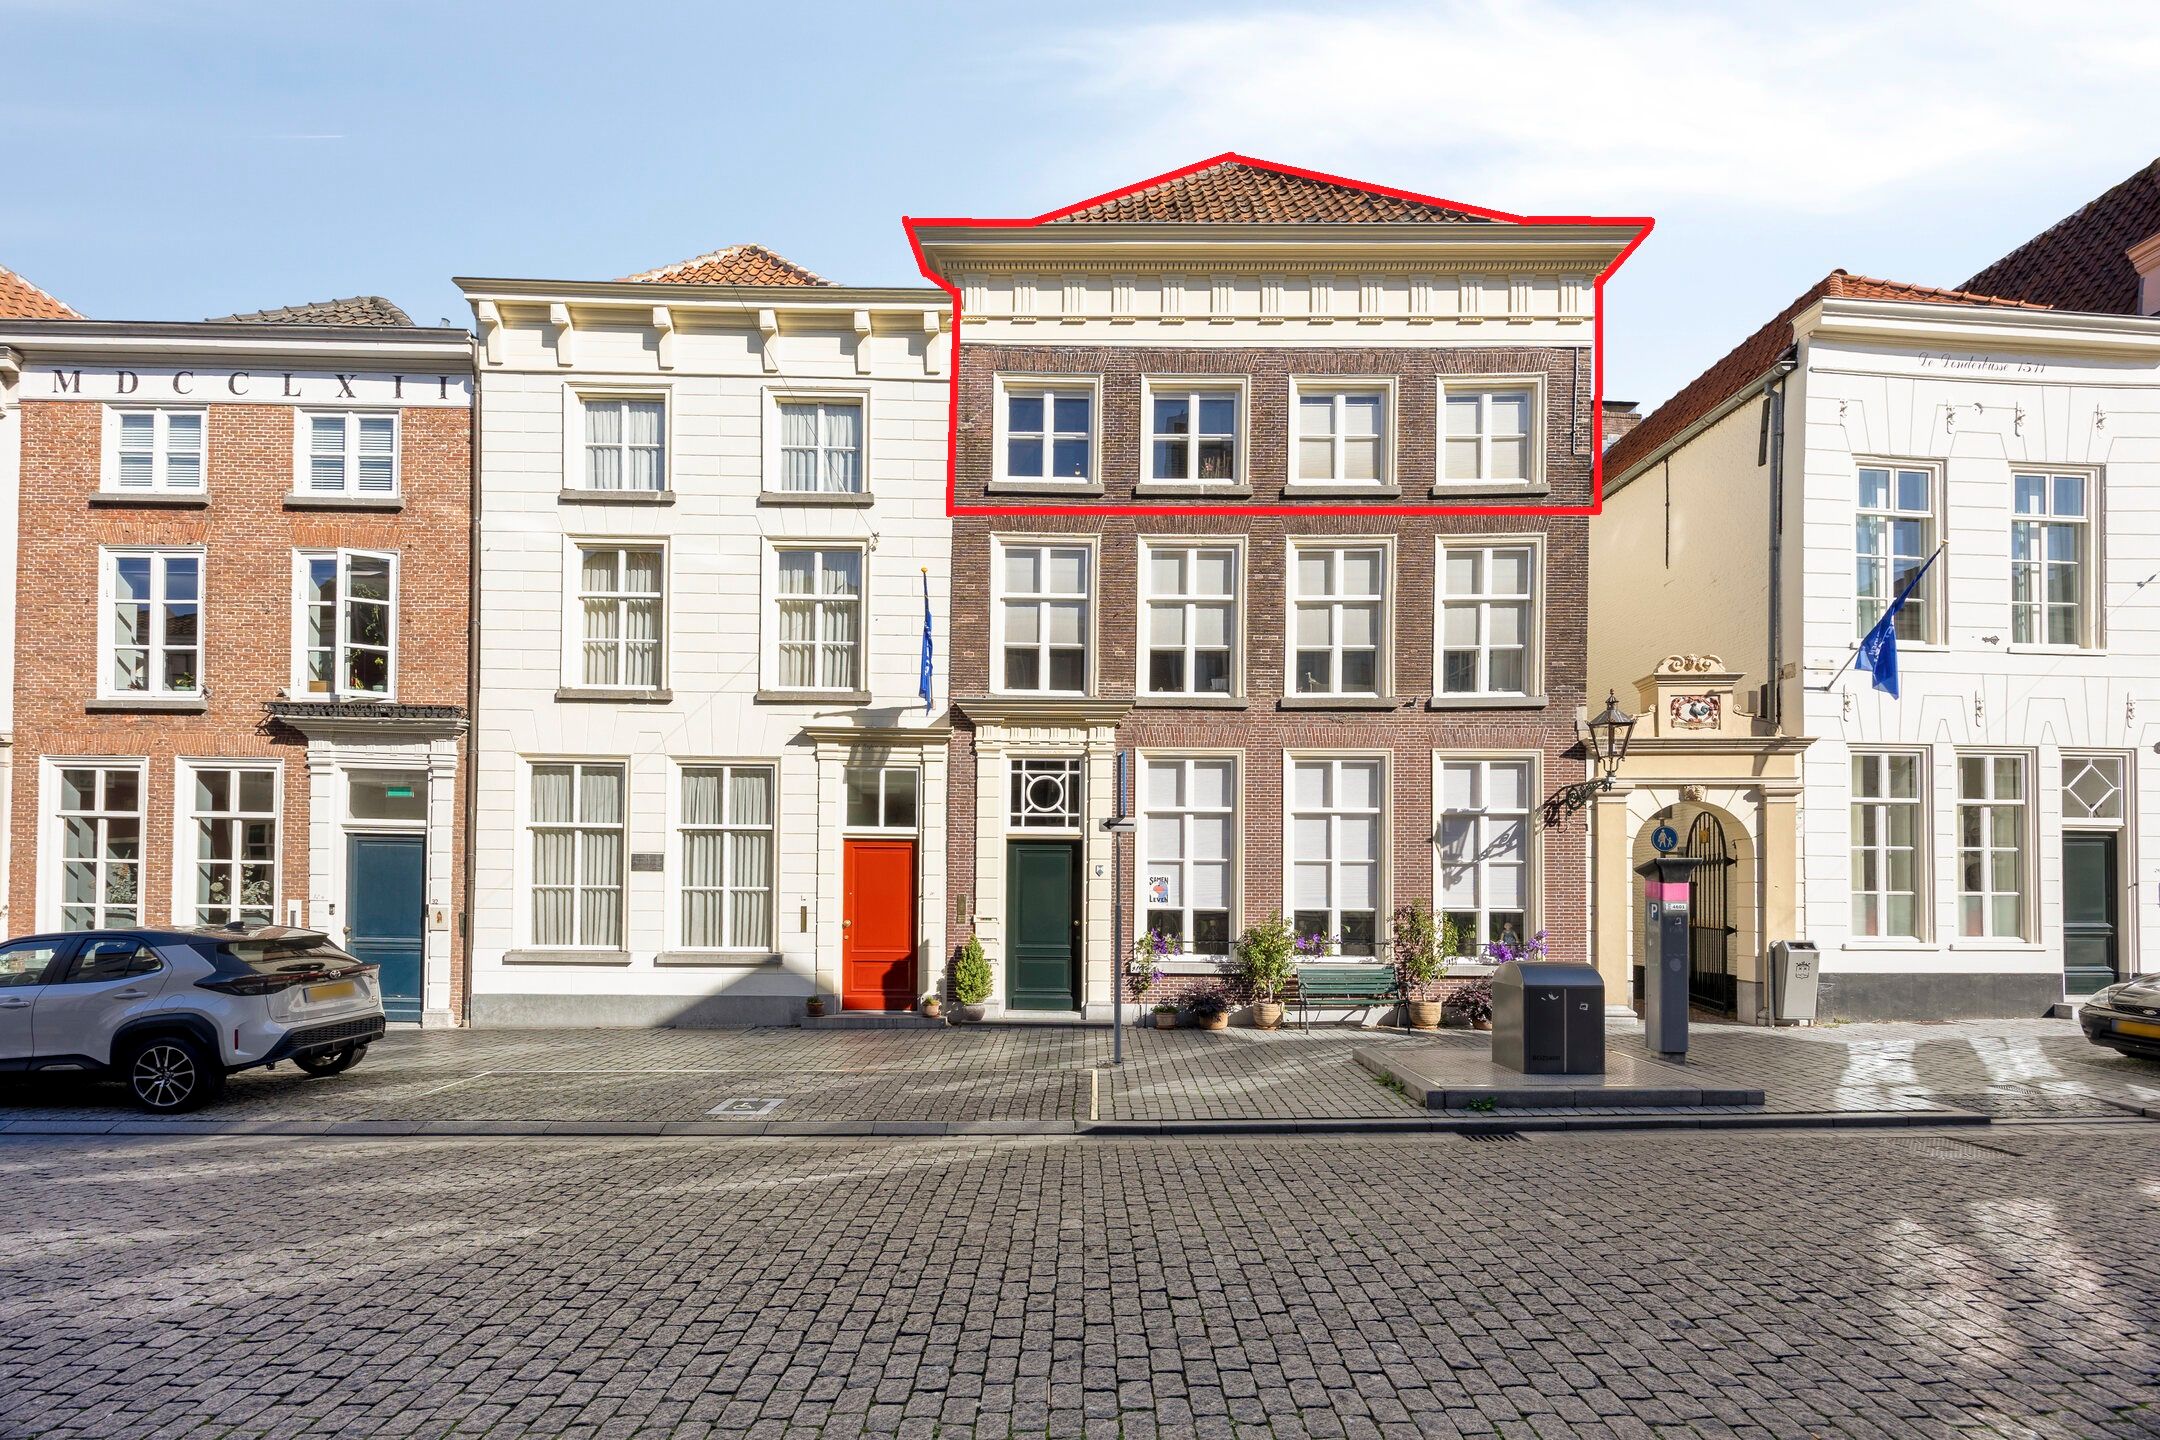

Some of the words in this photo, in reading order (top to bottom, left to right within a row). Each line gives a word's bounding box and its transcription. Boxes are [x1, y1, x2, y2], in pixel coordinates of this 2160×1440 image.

[52, 369, 449, 399] MDCCLXII
[1149, 876, 1168, 886] SAMEN
[1149, 894, 1168, 903] LEVEN
[1651, 903, 1658, 918] P
